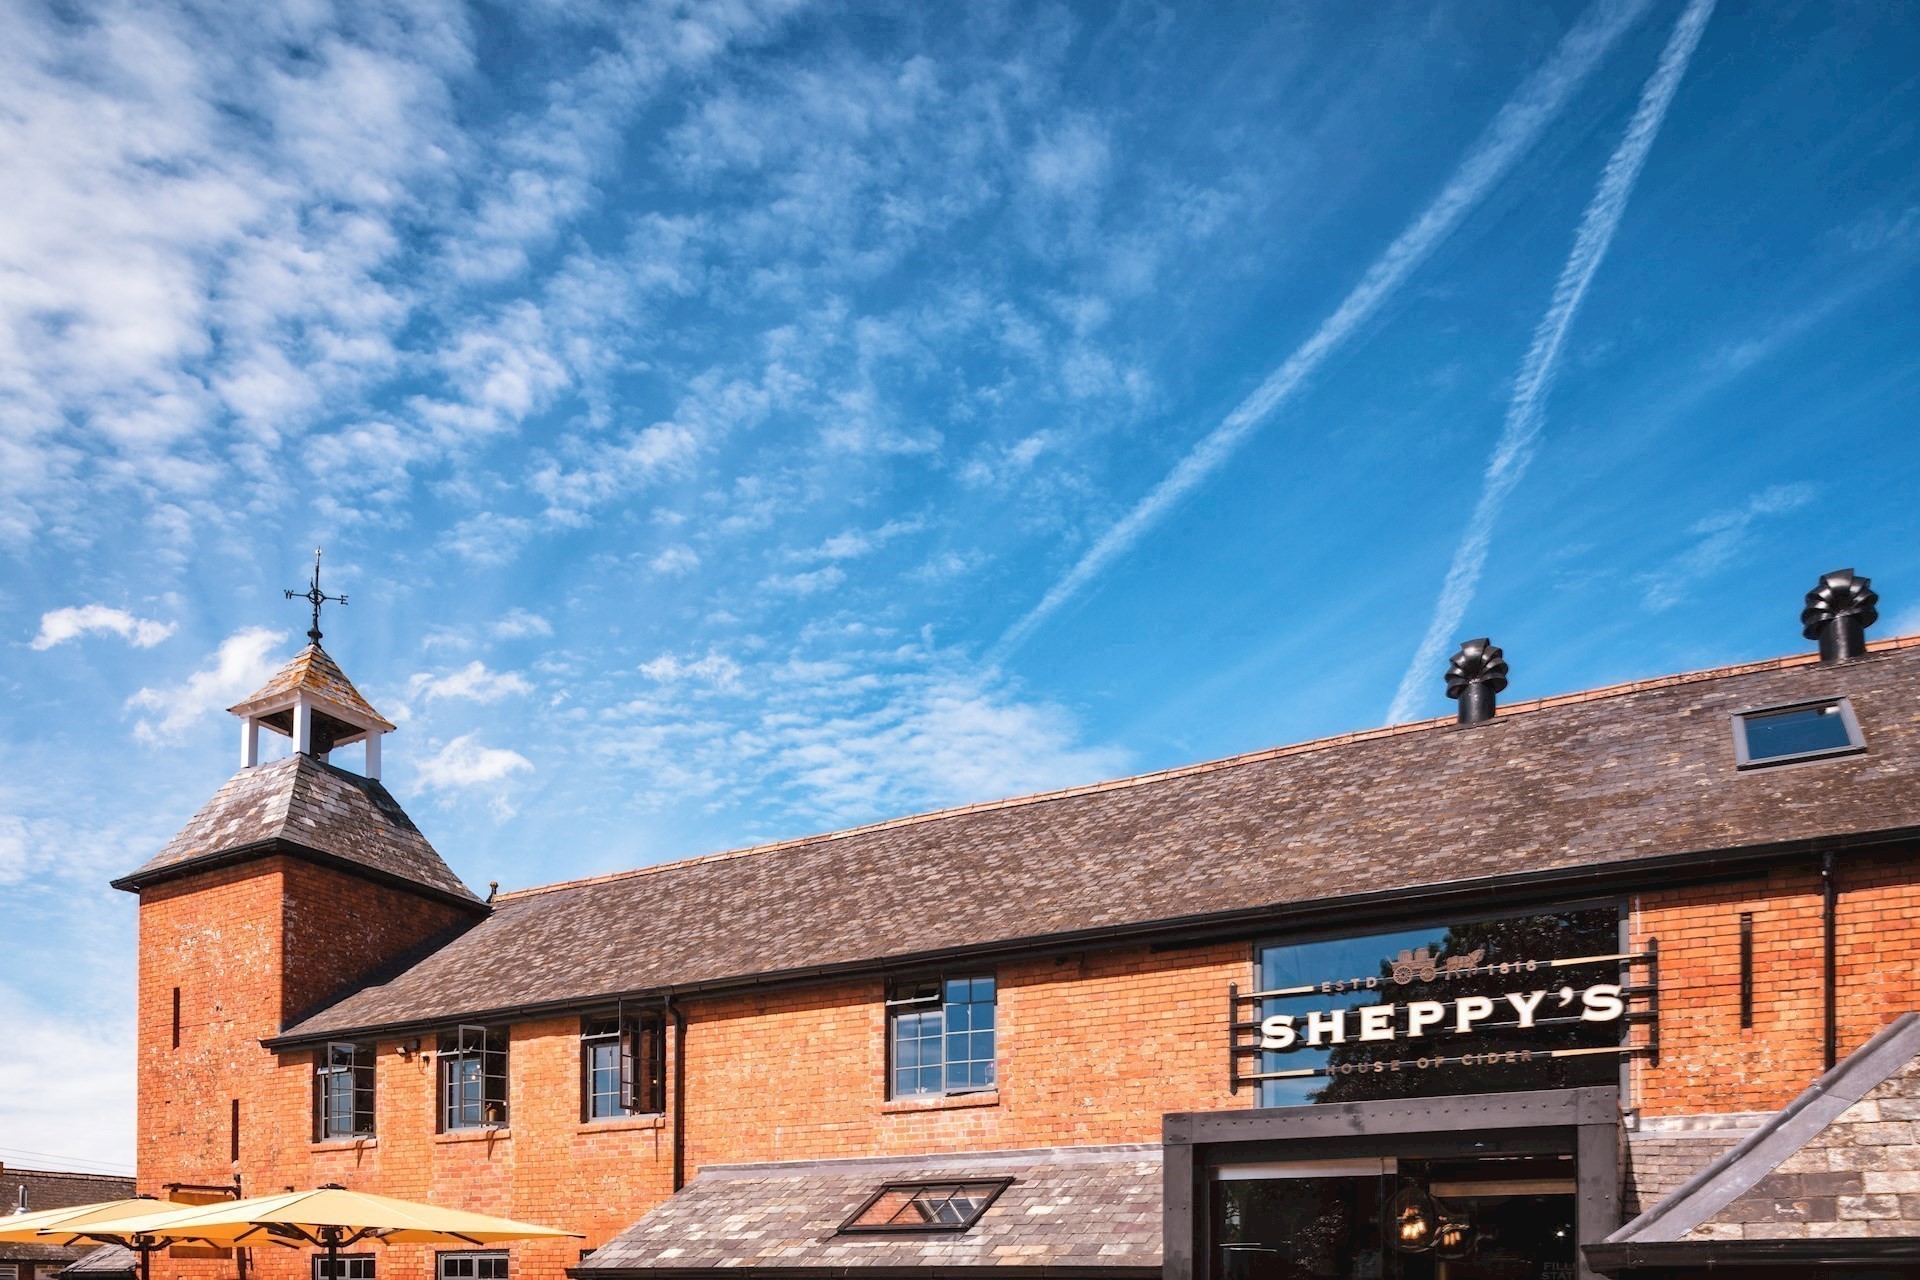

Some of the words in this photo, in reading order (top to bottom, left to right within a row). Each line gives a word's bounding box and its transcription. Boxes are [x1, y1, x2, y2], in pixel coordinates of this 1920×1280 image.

[1321, 977, 1378, 993] ESTD
[1260, 984, 1624, 1050] SHEPPY'S
[1325, 1060, 1400, 1076] HOUSE
[1416, 1056, 1444, 1069] OF
[1461, 1050, 1532, 1066] CIDER
